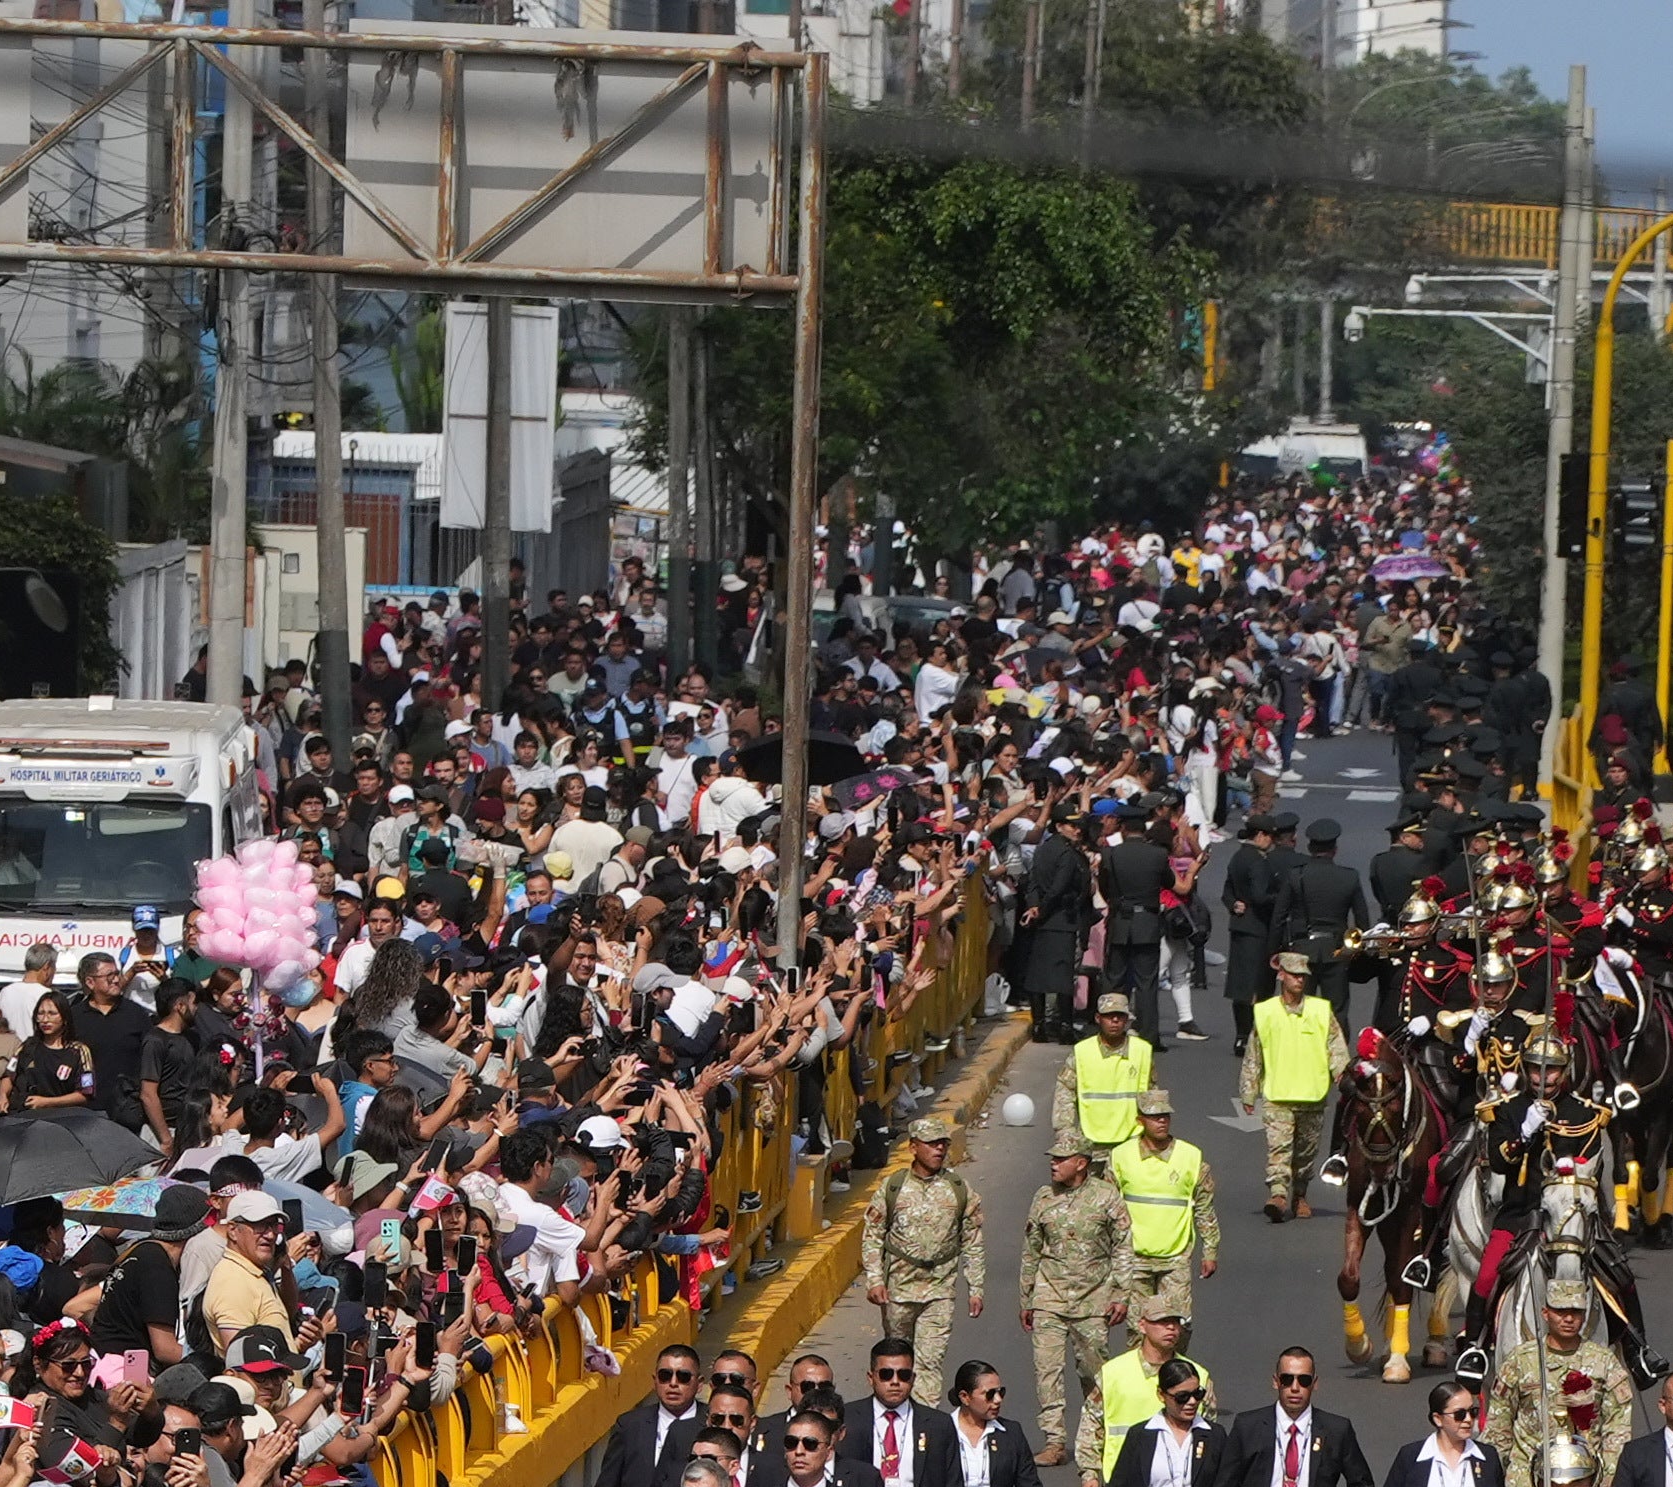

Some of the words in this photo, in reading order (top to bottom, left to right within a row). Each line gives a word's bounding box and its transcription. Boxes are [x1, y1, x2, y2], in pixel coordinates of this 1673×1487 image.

[10, 770, 51, 782] HOSPITAL
[54, 770, 88, 782] MILITAR
[90, 769, 142, 783] GERIÁTRICO
